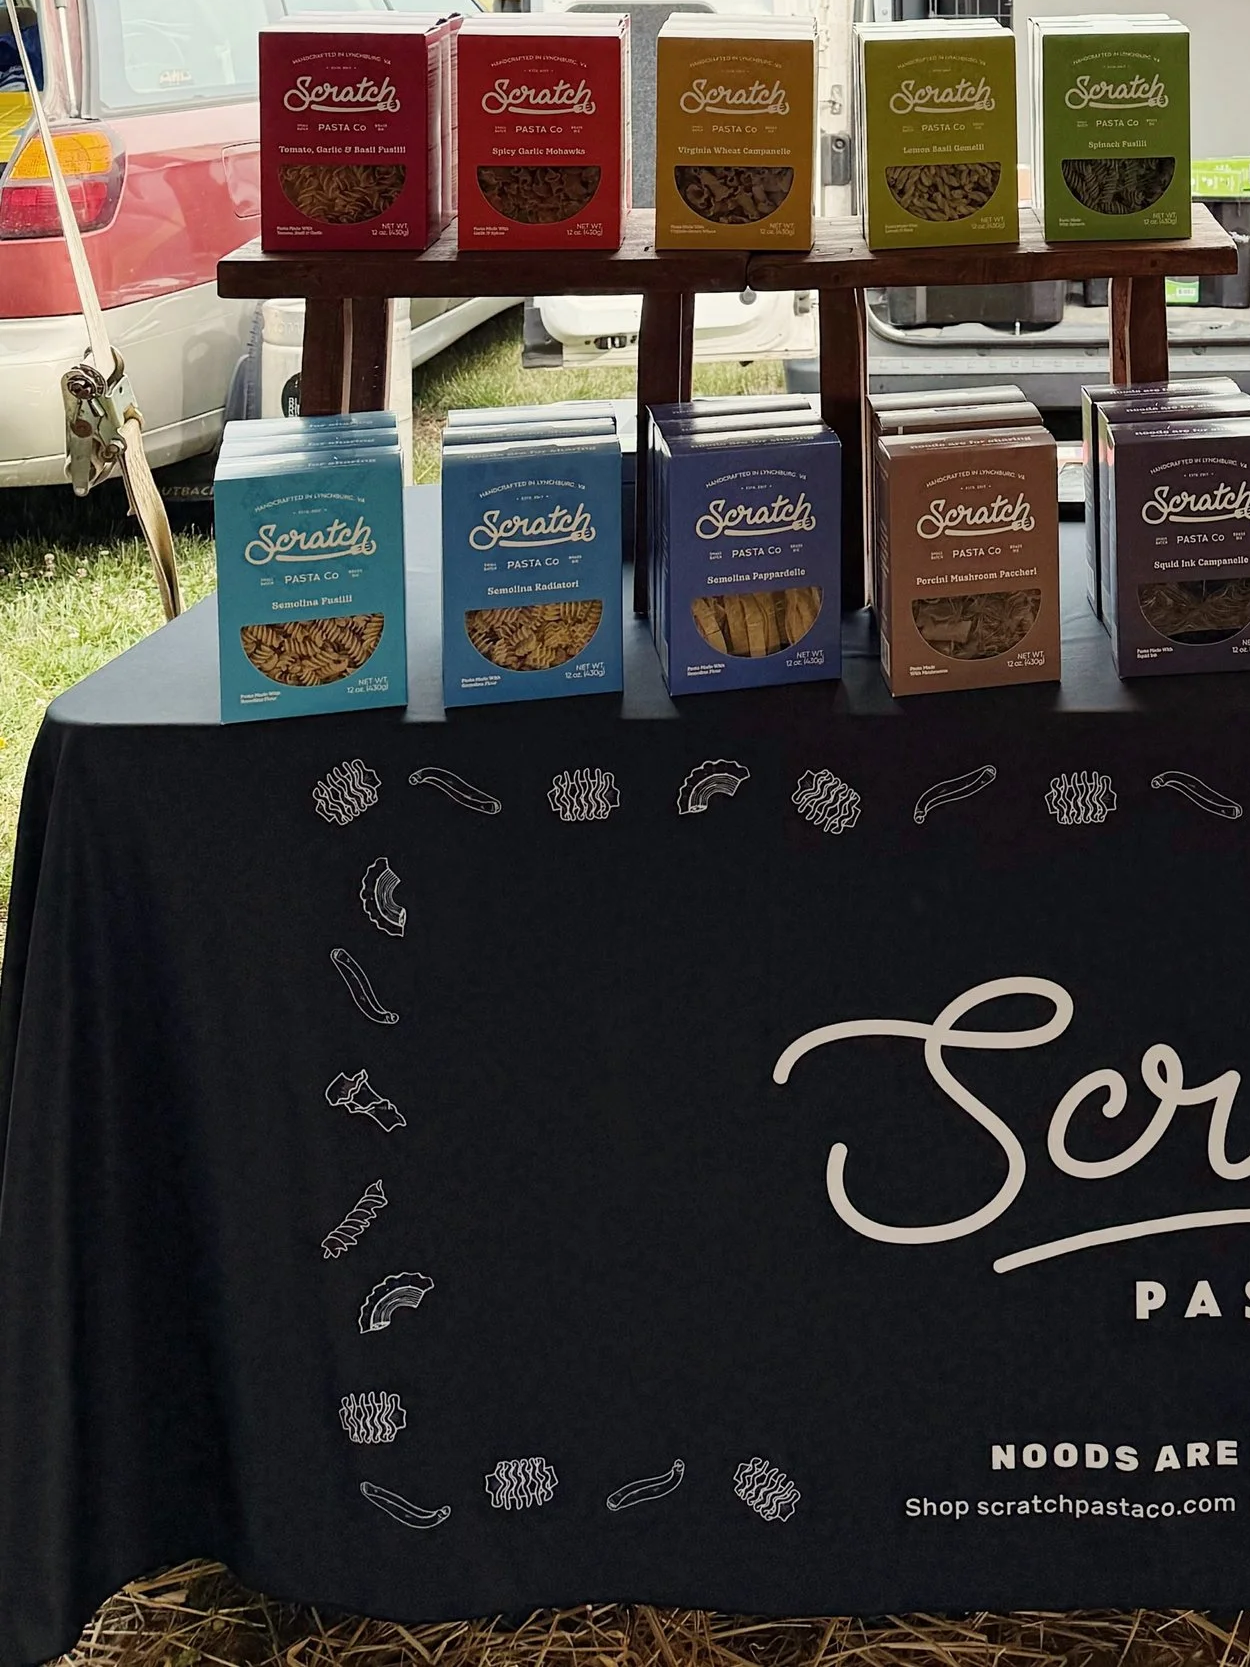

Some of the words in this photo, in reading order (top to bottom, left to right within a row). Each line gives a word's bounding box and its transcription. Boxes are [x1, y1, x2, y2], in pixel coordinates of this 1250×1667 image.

[283, 76, 400, 113] Scratch
[481, 79, 596, 115] Scratch
[679, 79, 790, 115] Scratch
[889, 77, 996, 114] Scratch
[1064, 73, 1169, 110] Scratch
[318, 123, 350, 132] PASTA
[515, 125, 547, 134] PASTA
[712, 125, 742, 134] PASTA
[921, 124, 951, 132] PASTA
[1096, 119, 1125, 127] PASTA
[278, 145, 315, 154] Tomato,
[316, 146, 343, 154] Garlic
[354, 146, 376, 154] Basil
[378, 146, 406, 154] Fusilli
[492, 147, 516, 156] Spicy
[518, 147, 544, 155] Garlic
[545, 147, 586, 155] Mohawks
[678, 146, 712, 156] Virginia
[713, 146, 741, 155] Wheat
[742, 147, 791, 156] Campanelle
[903, 146, 930, 154] Lemon
[932, 145, 952, 153] Basil
[953, 144, 985, 152] Gemelli
[1088, 141, 1120, 149] Spinach
[1122, 140, 1147, 148] Fusilli
[1150, 458, 1193, 475] HANDCRAFTED
[705, 471, 751, 488] HANDCRAFTED
[926, 471, 971, 488] HANDCRAFTED
[479, 481, 527, 498] HANDCRAFTED
[695, 492, 816, 540] Scratch
[916, 492, 1035, 540] Scratch
[469, 502, 596, 551] Scratch
[244, 516, 377, 565] Scratch
[1176, 534, 1209, 544] PASTA
[731, 548, 765, 558] PASTA
[952, 548, 985, 558] PASTA
[507, 559, 542, 570] PASTA
[1154, 560, 1180, 571] Squid
[1181, 559, 1196, 568] Ink
[1198, 556, 1249, 568] Campanelle
[284, 573, 320, 584] PASTA
[707, 574, 751, 585] Semolina
[752, 568, 806, 581] Pappardelle
[916, 575, 948, 586] Porcini
[950, 571, 998, 583] Mushroom
[1000, 567, 1038, 579] Paccheri
[487, 585, 533, 596] Semolina
[535, 580, 579, 591] Radiatori
[272, 598, 319, 610] Semolina
[321, 594, 353, 605] Fusilli
[796, 651, 810, 659] NET
[1017, 652, 1031, 660] NET
[992, 1442, 1139, 1472] NOODS
[1154, 1440, 1238, 1472] ARE
[905, 1497, 969, 1520] Shop
[976, 1494, 1236, 1519] scratchpastaco.com
